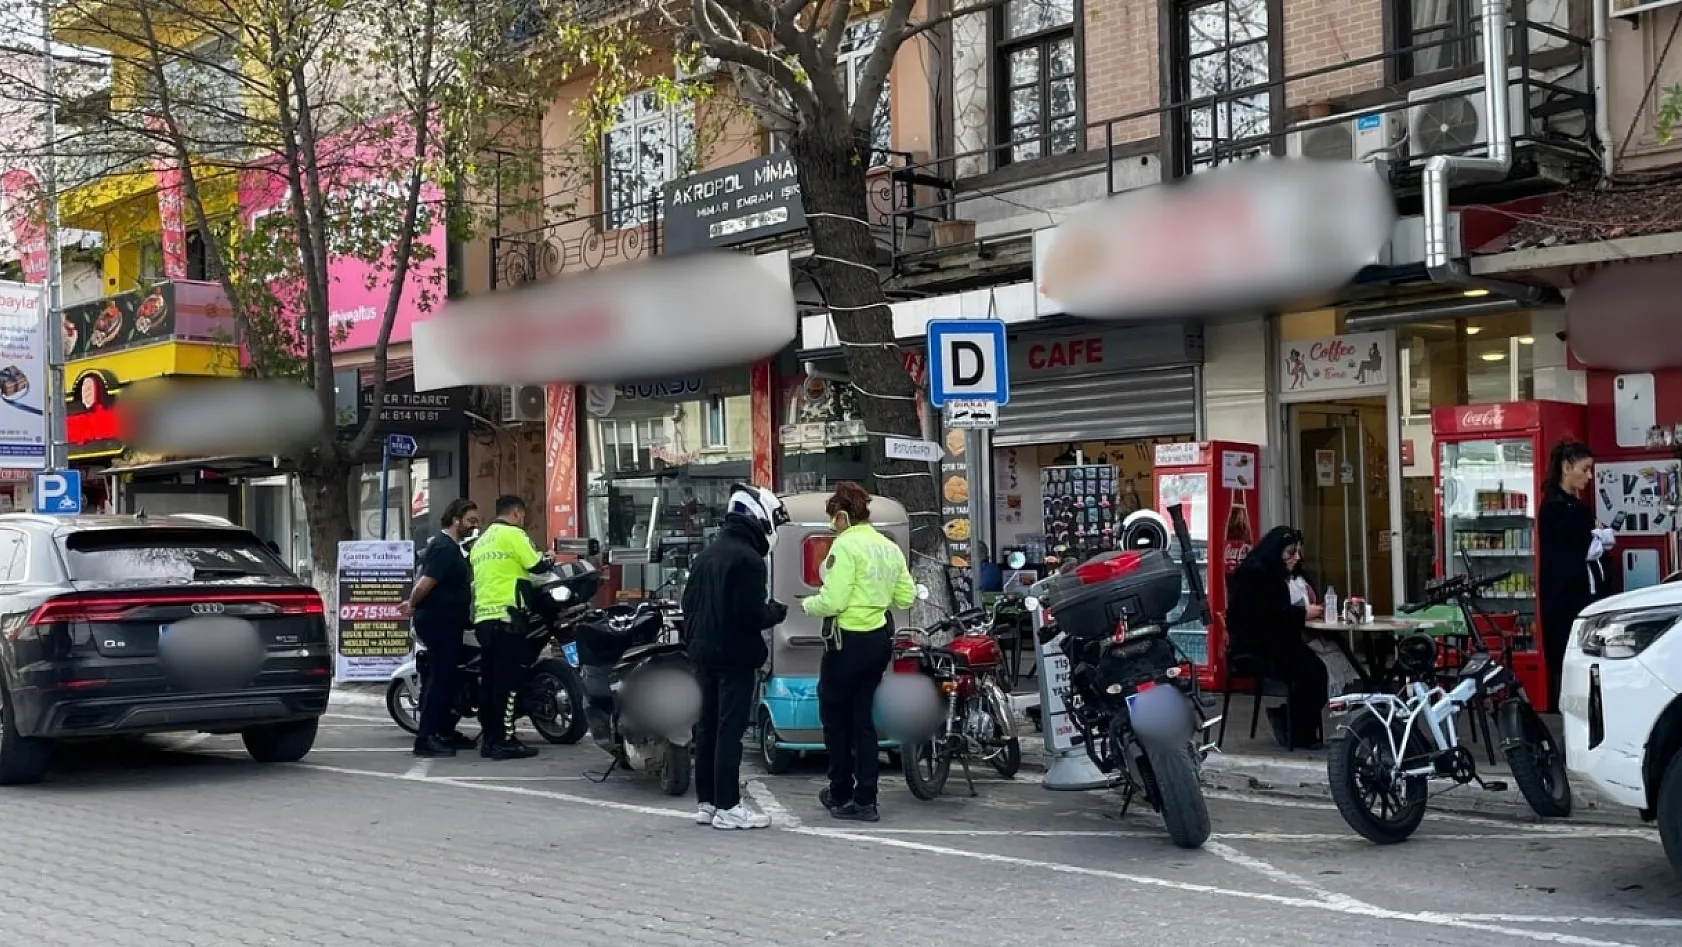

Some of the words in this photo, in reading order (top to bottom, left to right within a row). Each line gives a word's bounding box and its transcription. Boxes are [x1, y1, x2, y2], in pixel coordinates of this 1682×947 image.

[672, 173, 743, 206] AKROPOL
[754, 159, 798, 186] MİMA
[696, 202, 729, 217] MİMAR
[737, 191, 773, 209] EMRAH
[951, 341, 985, 386] D
[1028, 337, 1104, 370] CAFE
[1310, 340, 1356, 363] Coffee
[1462, 408, 1507, 428] Coca-Cola
[38, 474, 68, 509] P
[340, 605, 377, 618] 07-15
[1054, 657, 1068, 669] TİŞ
[1055, 674, 1070, 683] PU
